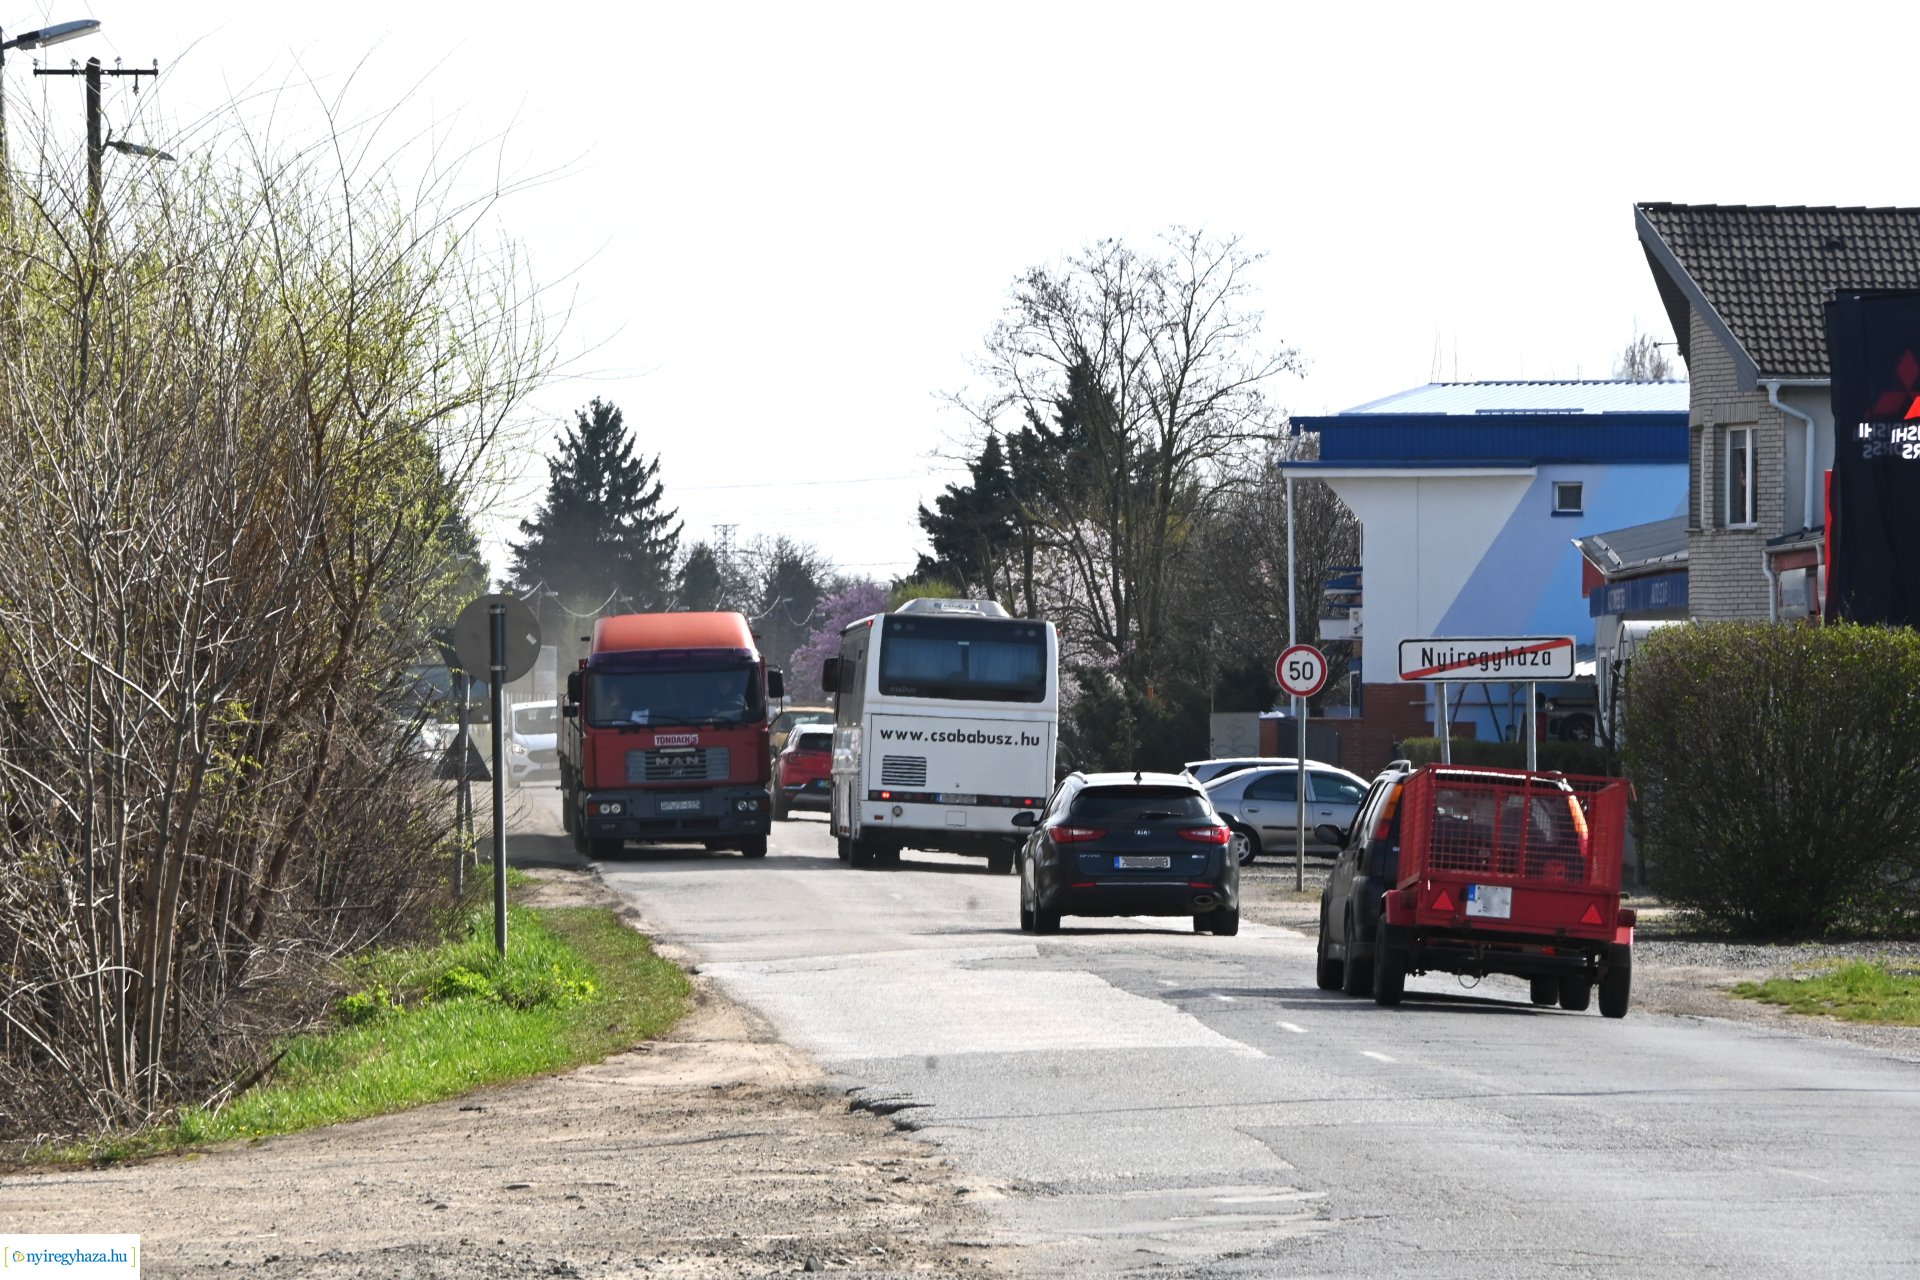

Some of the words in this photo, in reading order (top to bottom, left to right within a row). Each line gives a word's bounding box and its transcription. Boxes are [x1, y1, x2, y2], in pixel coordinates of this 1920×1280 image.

[1289, 661, 1314, 681] 50
[880, 728, 1040, 747] www.csababusz.hu
[655, 756, 700, 767] MAN
